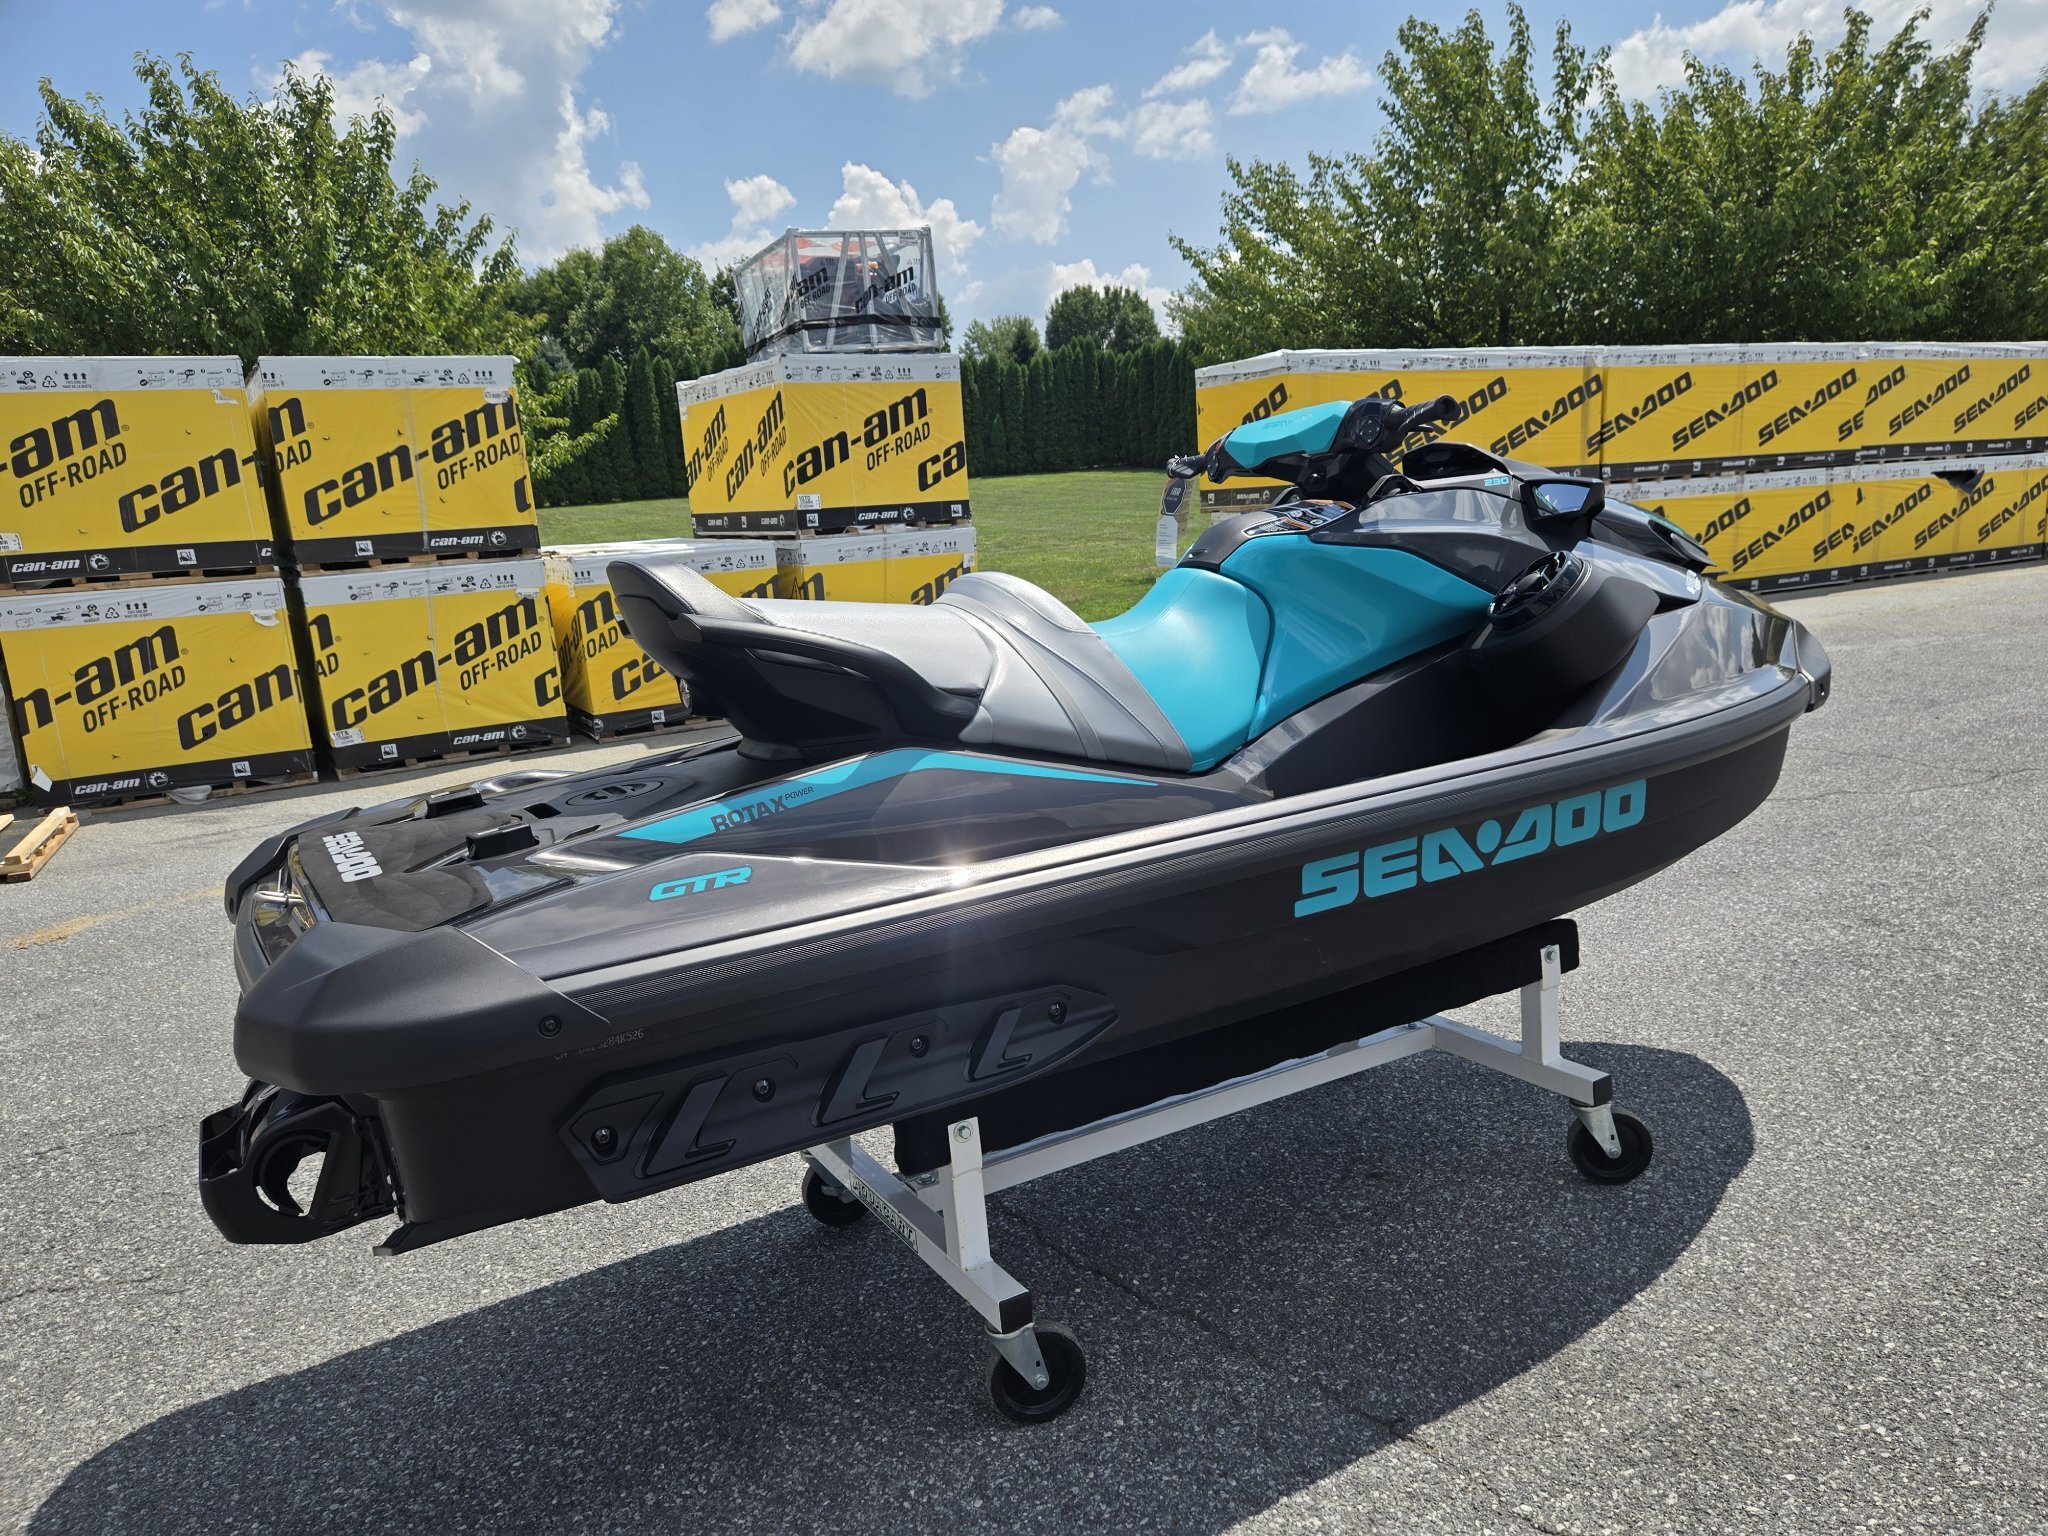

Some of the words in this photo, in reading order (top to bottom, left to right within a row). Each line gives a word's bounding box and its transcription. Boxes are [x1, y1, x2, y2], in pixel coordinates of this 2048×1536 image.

[304, 396, 522, 526] can-am
[437, 432, 520, 490] OFF-ROAD
[686, 403, 726, 491] an-am
[726, 390, 784, 502] can-am
[760, 425, 787, 477] OFF-ROAD
[783, 387, 927, 499] can-am
[867, 421, 930, 471] OFF-ROAD
[19, 442, 127, 508] OFF-ROAD
[430, 532, 484, 547] can-am
[858, 510, 898, 521] can-am
[11, 559, 80, 573] can-am
[14, 625, 180, 737] n-am
[332, 597, 538, 730] can-am
[460, 631, 542, 691] OFF-ROAD
[82, 665, 186, 733] OFF-ROAD
[453, 730, 505, 746] can-am
[75, 776, 140, 795] can-am
[710, 796, 789, 833] ROTAX
[784, 786, 814, 801] POWER
[650, 865, 752, 901] GTR
